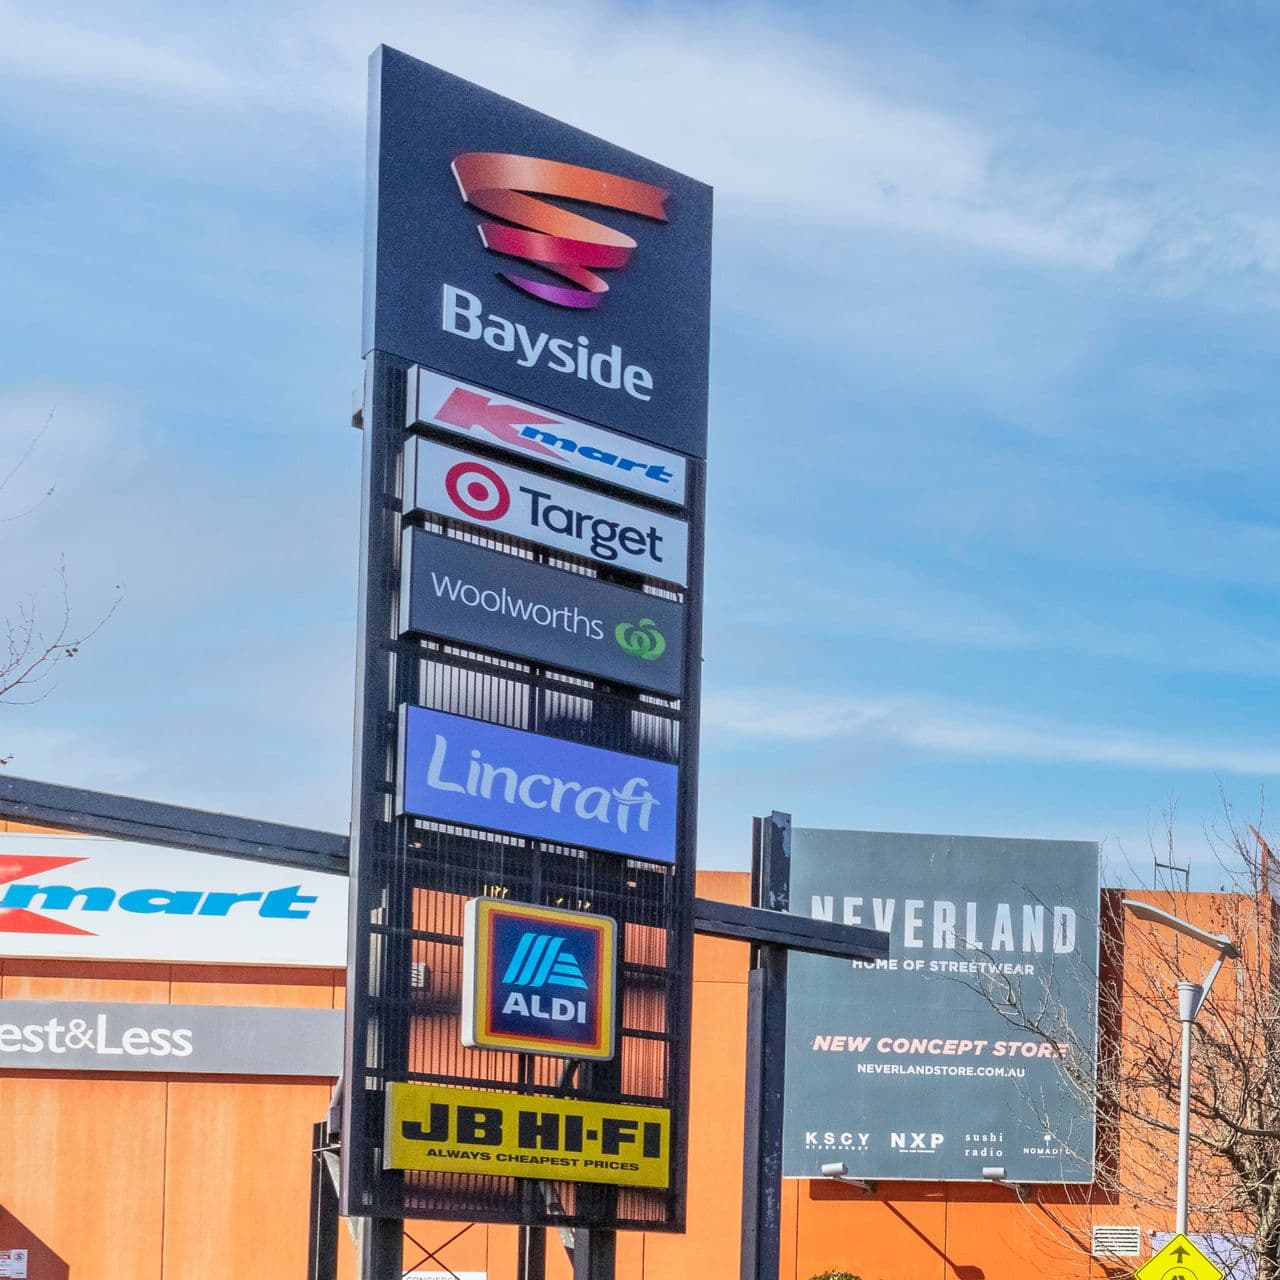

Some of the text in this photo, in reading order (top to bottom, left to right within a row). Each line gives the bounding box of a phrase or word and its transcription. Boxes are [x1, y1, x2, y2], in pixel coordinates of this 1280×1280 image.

[442, 283, 654, 402] Bayside
[434, 386, 674, 484] Kmart
[519, 486, 663, 562] Target
[430, 572, 605, 641] Woolworths
[427, 734, 661, 833] Lincraft
[811, 896, 1076, 954] NEVERLAND
[903, 960, 925, 971] OF
[930, 960, 1034, 975] STREETWEAR
[502, 992, 587, 1024] ALDI
[0, 1014, 193, 1057] est&Less
[812, 1036, 1070, 1058] NEW CONCEPT STORE
[857, 1063, 1025, 1078] NEVERLANDSTORE.COM.AU
[402, 1103, 503, 1146] JB
[805, 1131, 870, 1145] KSCY
[891, 1133, 944, 1148] NXP
[965, 1132, 1003, 1142] sushi
[427, 1148, 640, 1171] ALWAYS CHEAPEST PRICES
[965, 1147, 1003, 1157] radio
